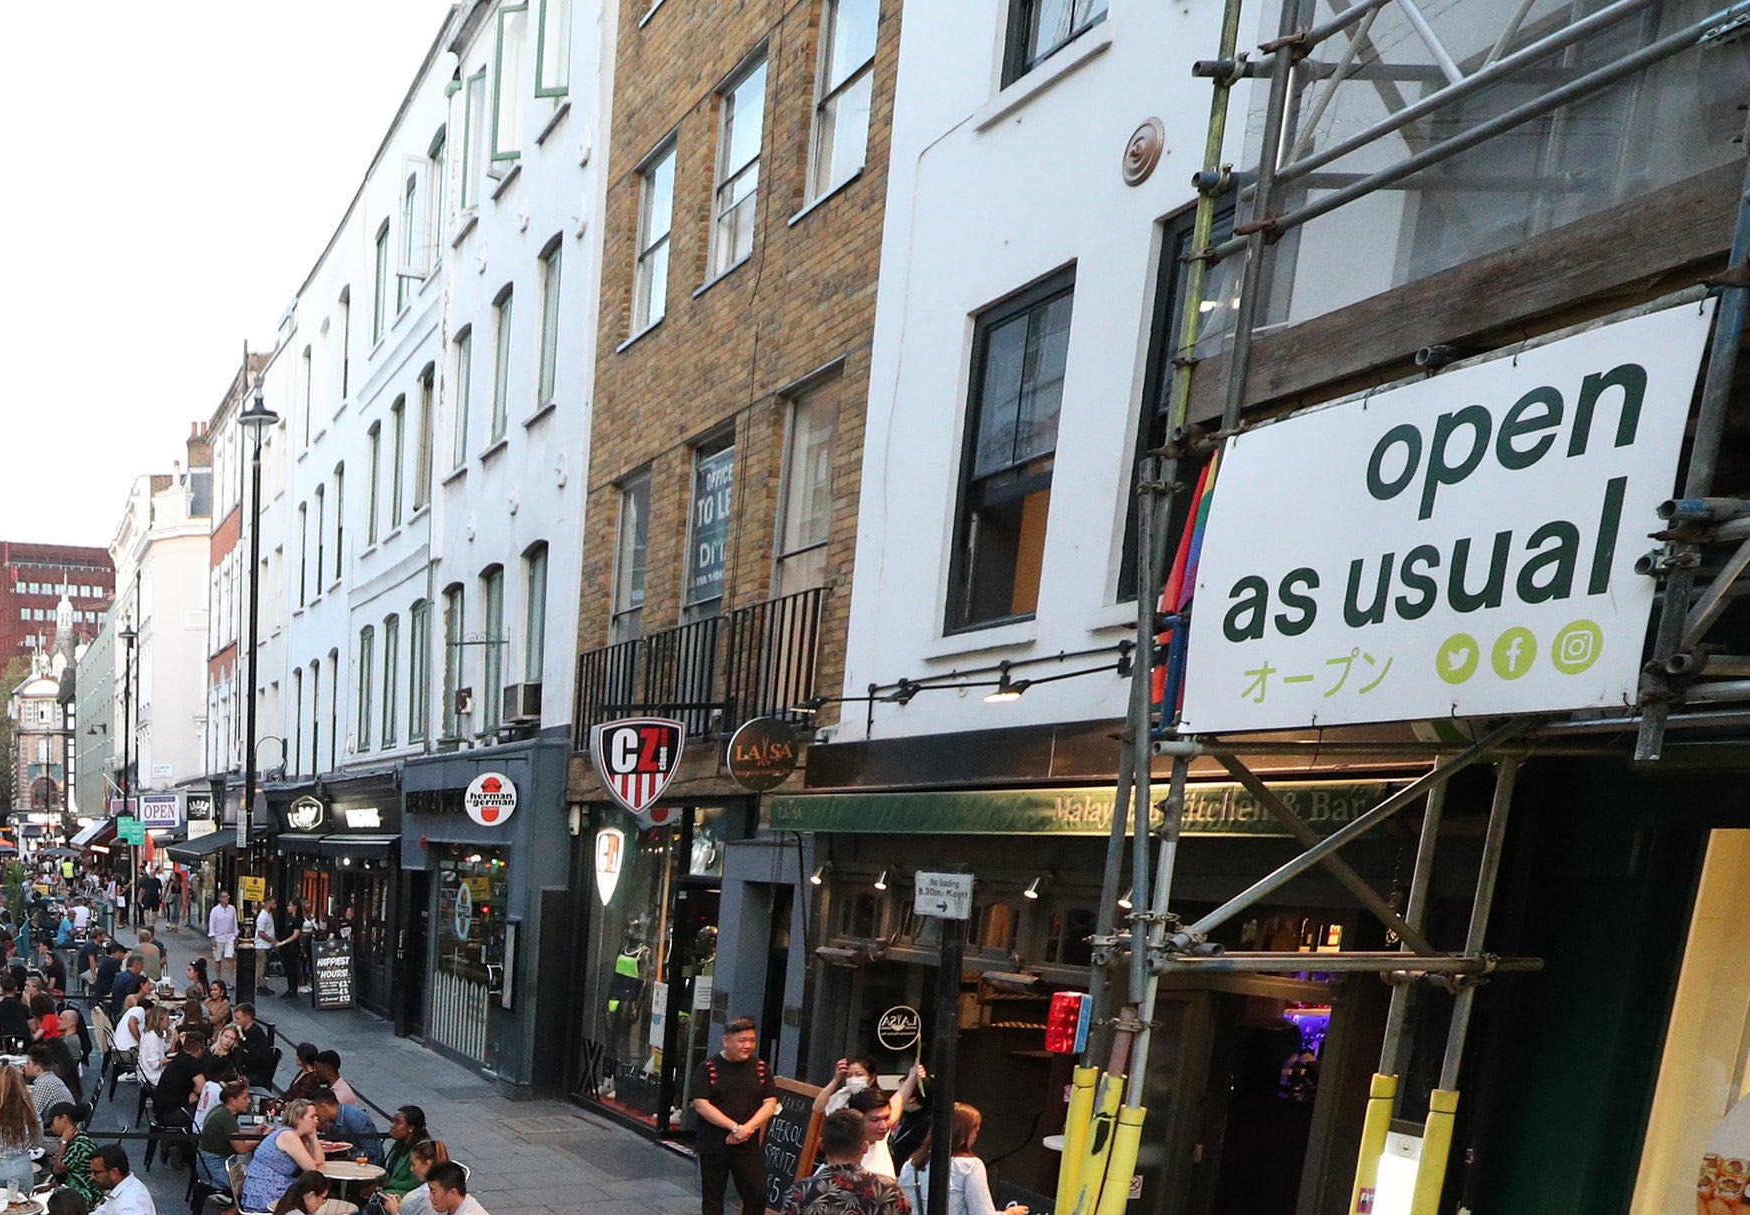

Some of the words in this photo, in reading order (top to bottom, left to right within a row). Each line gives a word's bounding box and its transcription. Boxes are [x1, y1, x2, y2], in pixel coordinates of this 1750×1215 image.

[1366, 363, 1648, 520] open
[697, 494, 714, 528] TO
[718, 487, 732, 519] LE
[1223, 567, 1320, 643] as
[1343, 476, 1628, 629] usual
[1241, 646, 1394, 703] オープン
[611, 728, 661, 773] CZ
[144, 804, 176, 819] OPEN
[470, 792, 513, 800] herman
[472, 799, 515, 808] german
[1309, 789, 1365, 822] Bar
[316, 956, 350, 967] HAPPIEST
[768, 1117, 803, 1148] APEROL
[764, 1142, 796, 1177] SPRITZ
